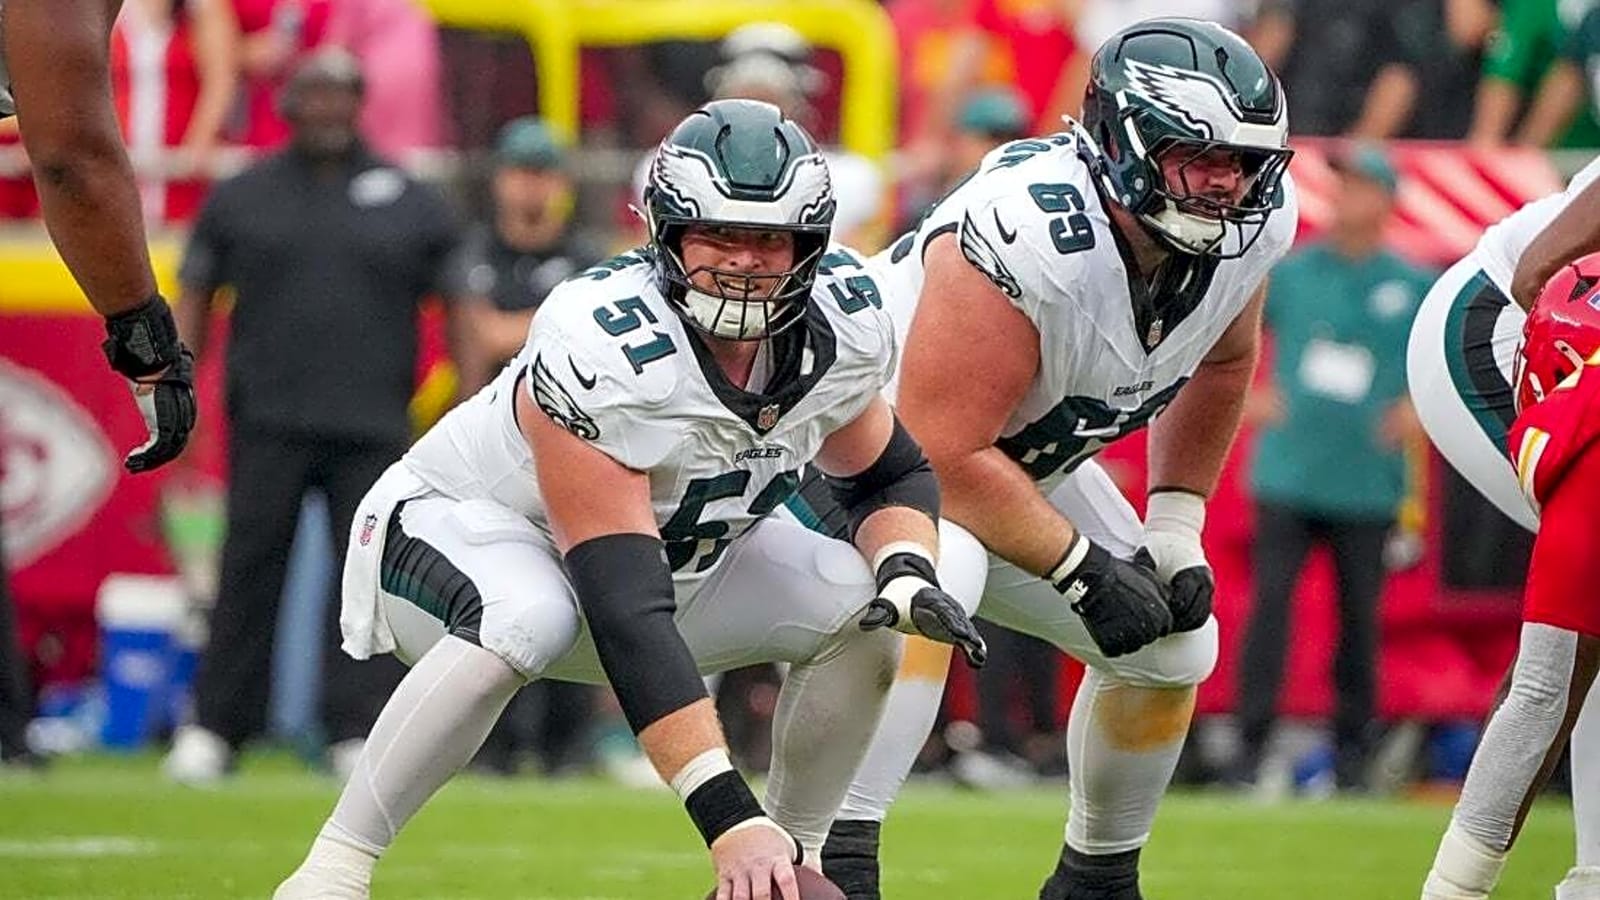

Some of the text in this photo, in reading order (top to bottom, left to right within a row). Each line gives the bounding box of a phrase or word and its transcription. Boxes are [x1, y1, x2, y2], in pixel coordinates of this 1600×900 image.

[1028, 183, 1095, 255] 69
[593, 295, 677, 376] 51
[1113, 380, 1155, 396] EAGLES
[735, 447, 784, 463] EAGLES
